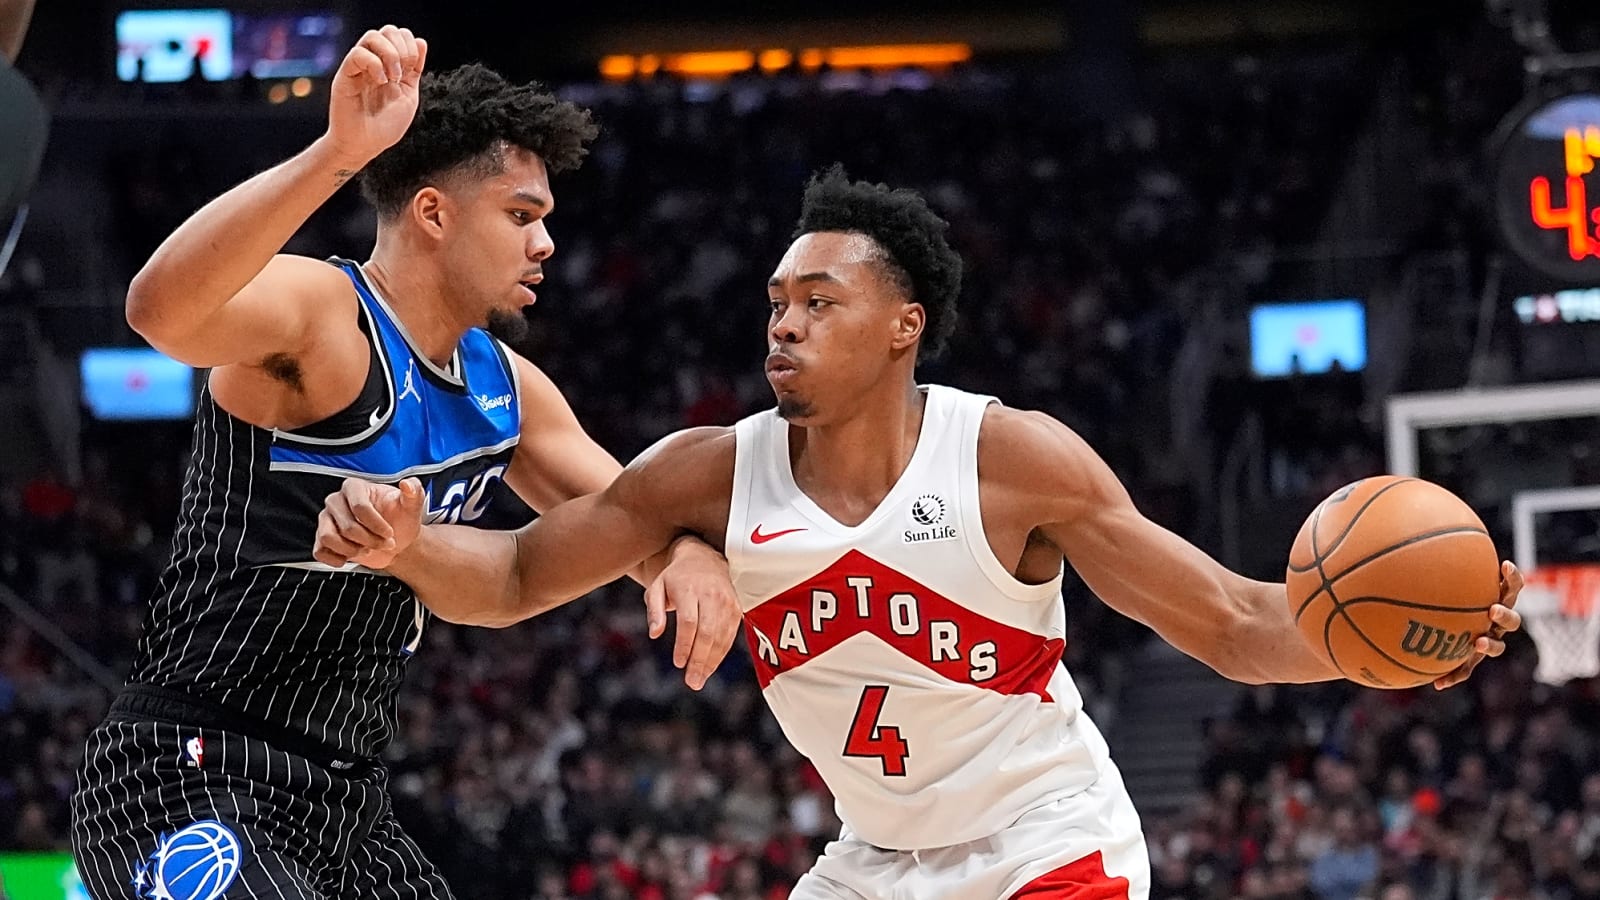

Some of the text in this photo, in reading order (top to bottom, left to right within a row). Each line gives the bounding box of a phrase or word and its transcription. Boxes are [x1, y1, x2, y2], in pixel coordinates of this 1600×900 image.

[904, 525, 957, 543] Sun Life
[752, 575, 999, 682] RAPTORS
[842, 684, 910, 777] 4
